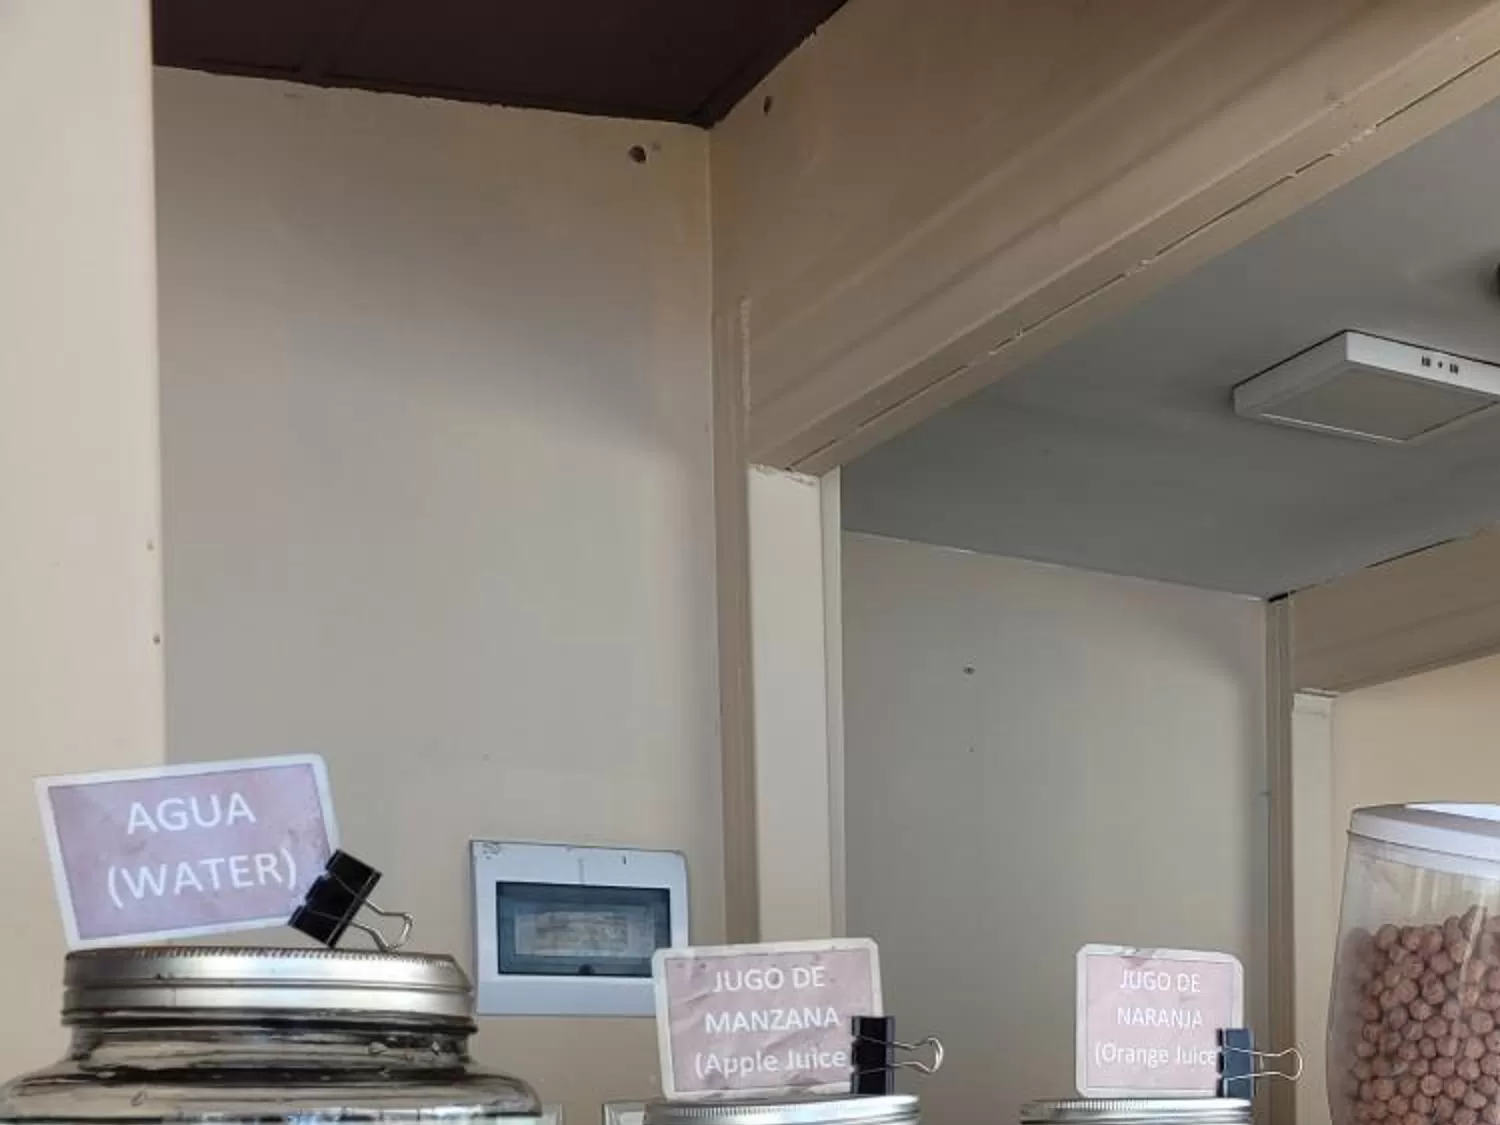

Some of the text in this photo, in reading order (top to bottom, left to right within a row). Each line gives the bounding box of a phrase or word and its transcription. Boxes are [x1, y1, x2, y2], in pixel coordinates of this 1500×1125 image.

[126, 791, 257, 835] AGUA
[106, 847, 298, 910] (WATER)
[712, 965, 827, 993] JUGO DE
[1119, 970, 1201, 993] JUGO DE
[704, 1006, 842, 1034] MANZANA
[1116, 1007, 1205, 1029] NARANJA
[694, 1050, 780, 1080] (Apple
[1094, 1041, 1169, 1070] (Orange
